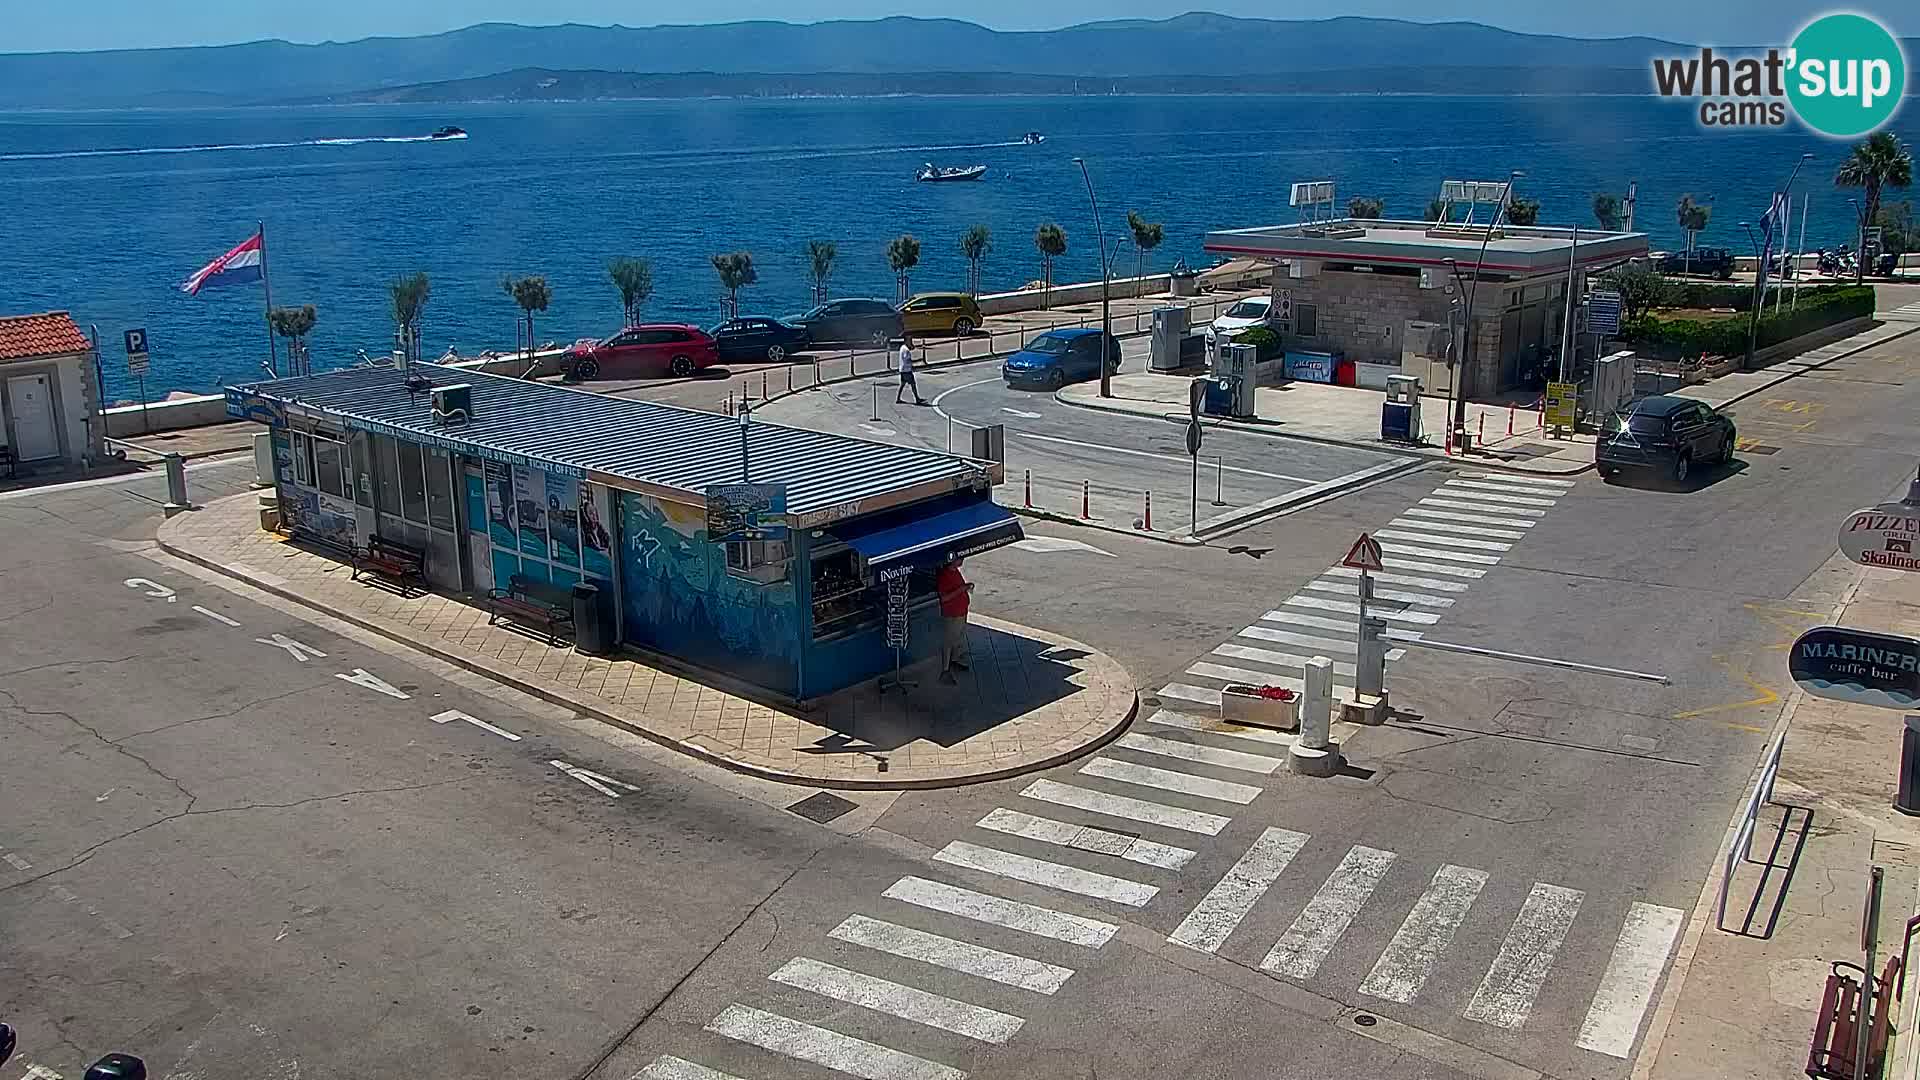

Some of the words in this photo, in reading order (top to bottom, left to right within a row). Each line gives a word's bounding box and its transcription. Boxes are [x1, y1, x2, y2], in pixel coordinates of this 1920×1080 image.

[130, 333, 141, 349] P
[436, 438, 468, 453] POSTAJA
[478, 447, 493, 458] BUS
[494, 452, 526, 465] STATION
[528, 458, 554, 472] TICKET
[555, 464, 583, 478] OFFICE
[1882, 530, 1916, 540] GRILL
[1830, 661, 1867, 674] caffe
[1872, 666, 1898, 680] bar
